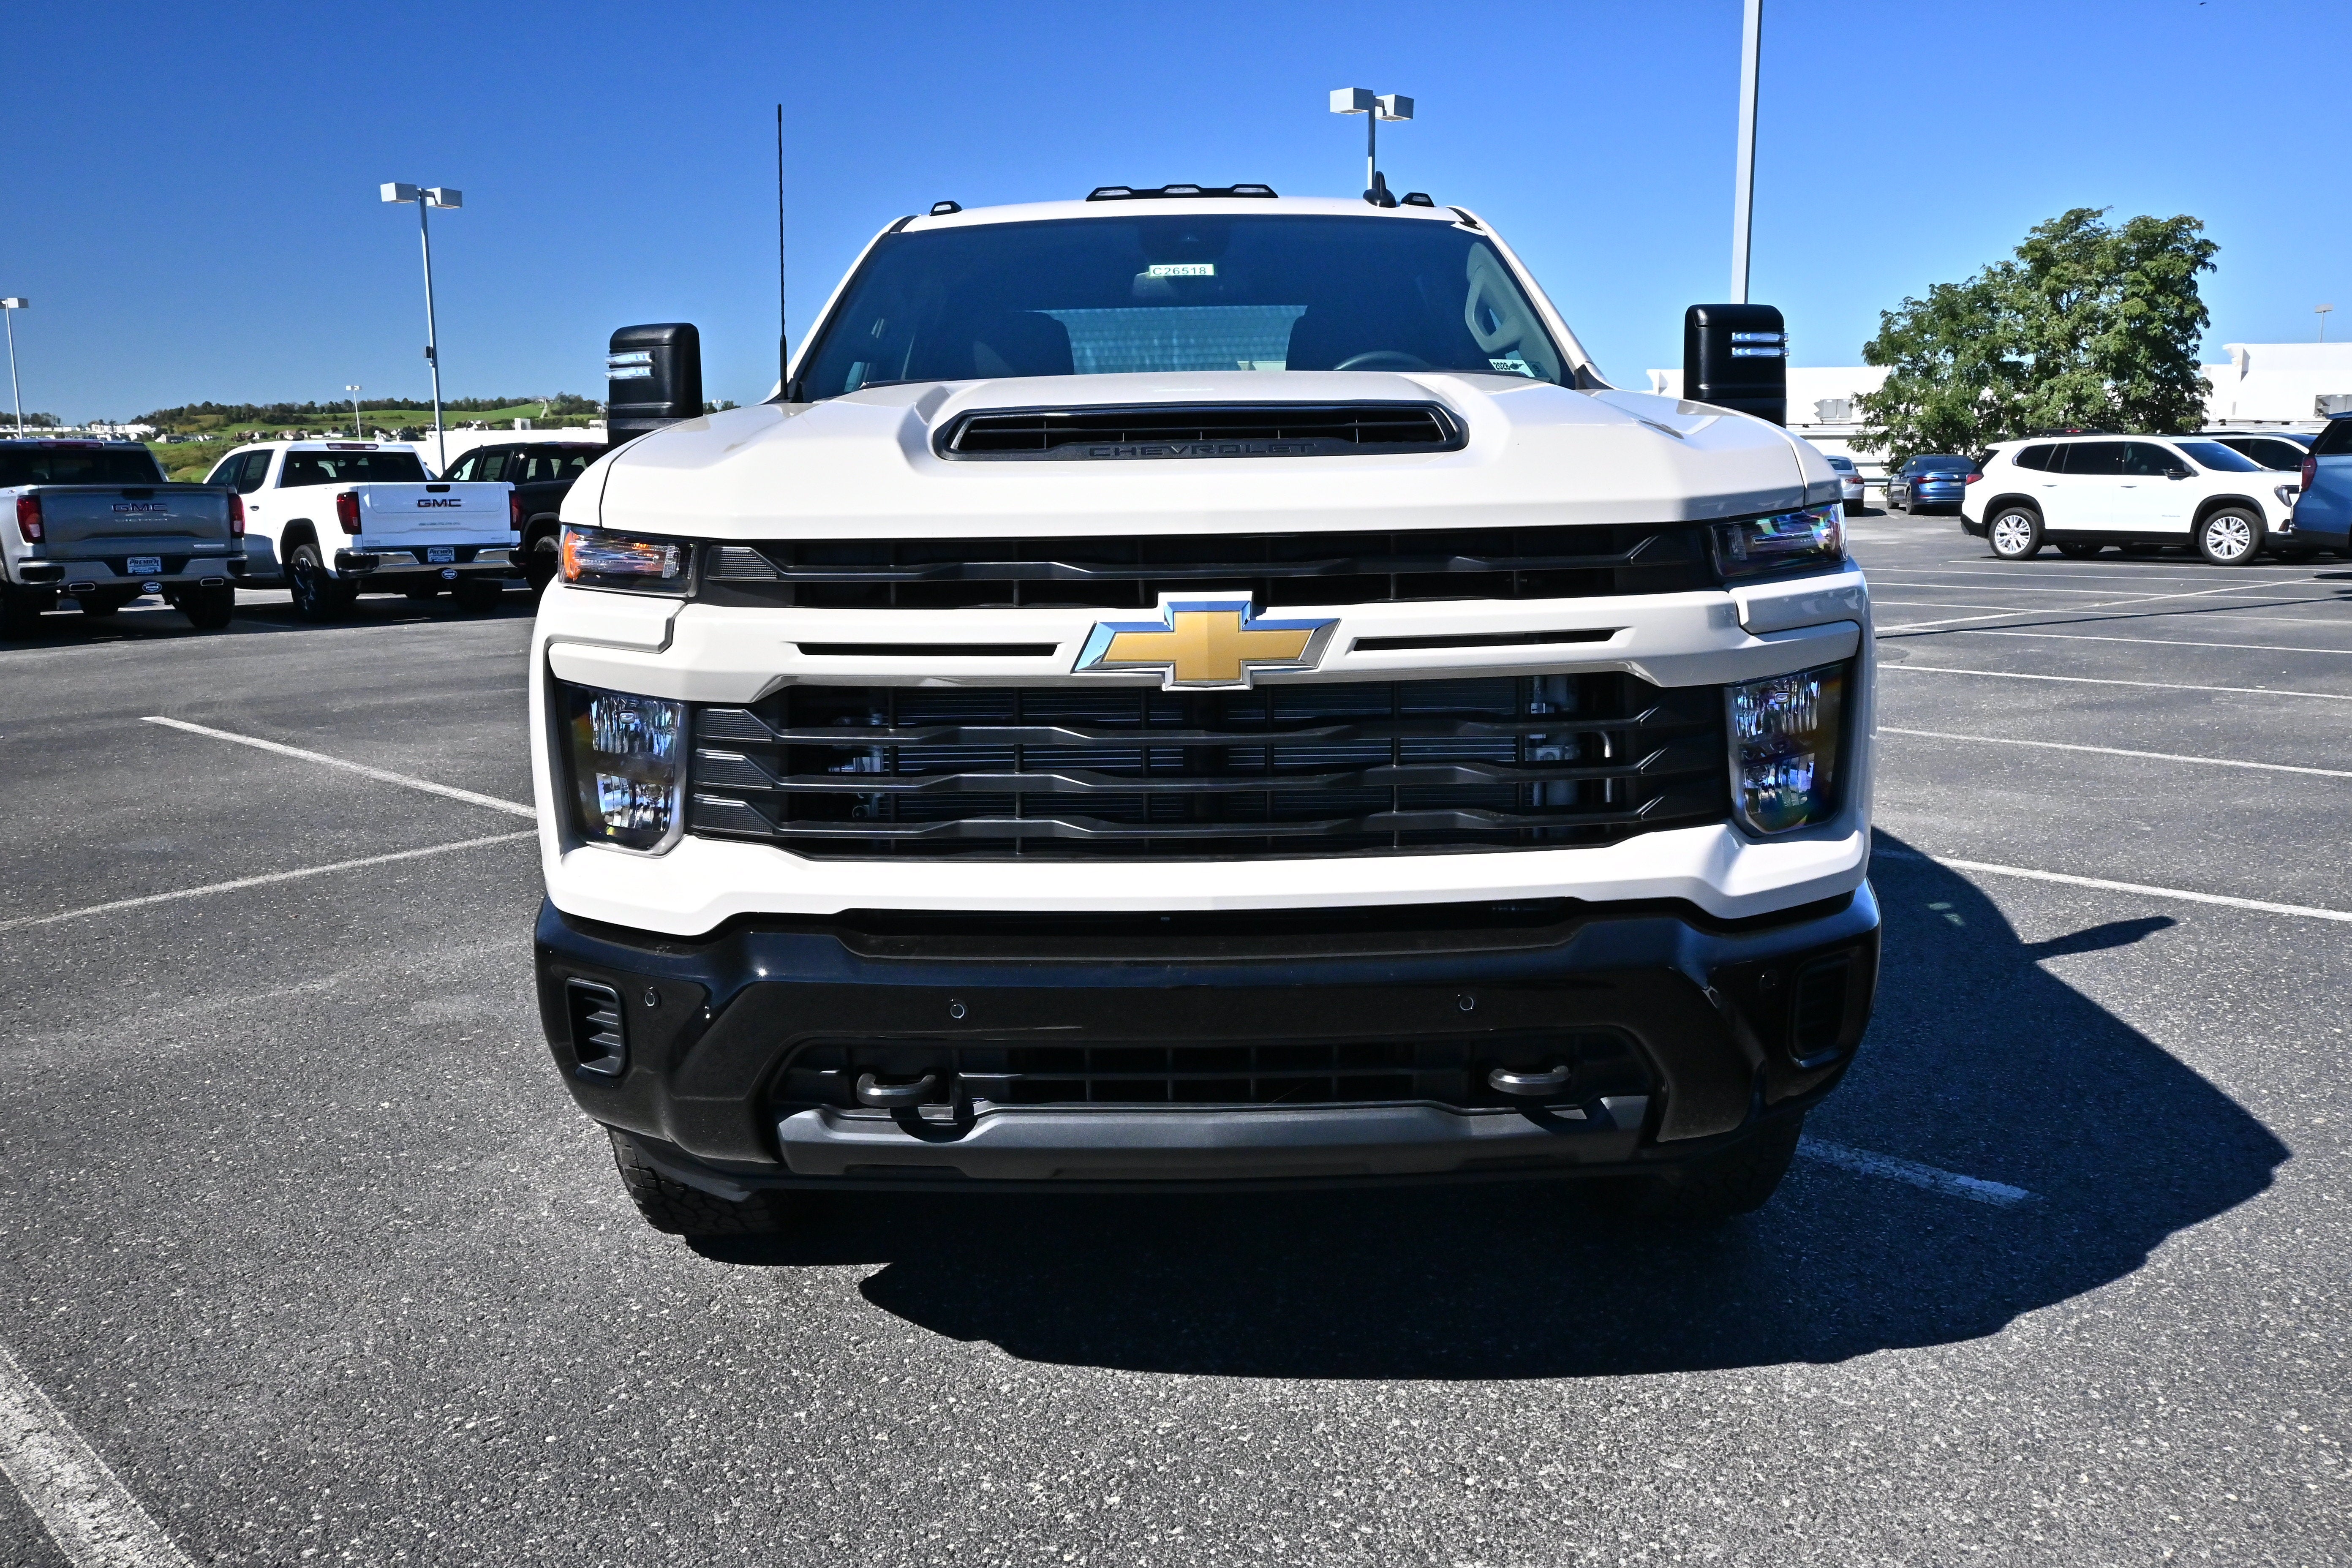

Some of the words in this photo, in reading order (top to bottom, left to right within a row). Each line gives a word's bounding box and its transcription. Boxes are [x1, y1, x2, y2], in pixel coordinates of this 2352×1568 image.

[1153, 267, 1206, 275] C26518
[1089, 444, 1316, 457] CHEVROLET
[416, 499, 461, 507] GMC
[112, 503, 168, 512] GMC
